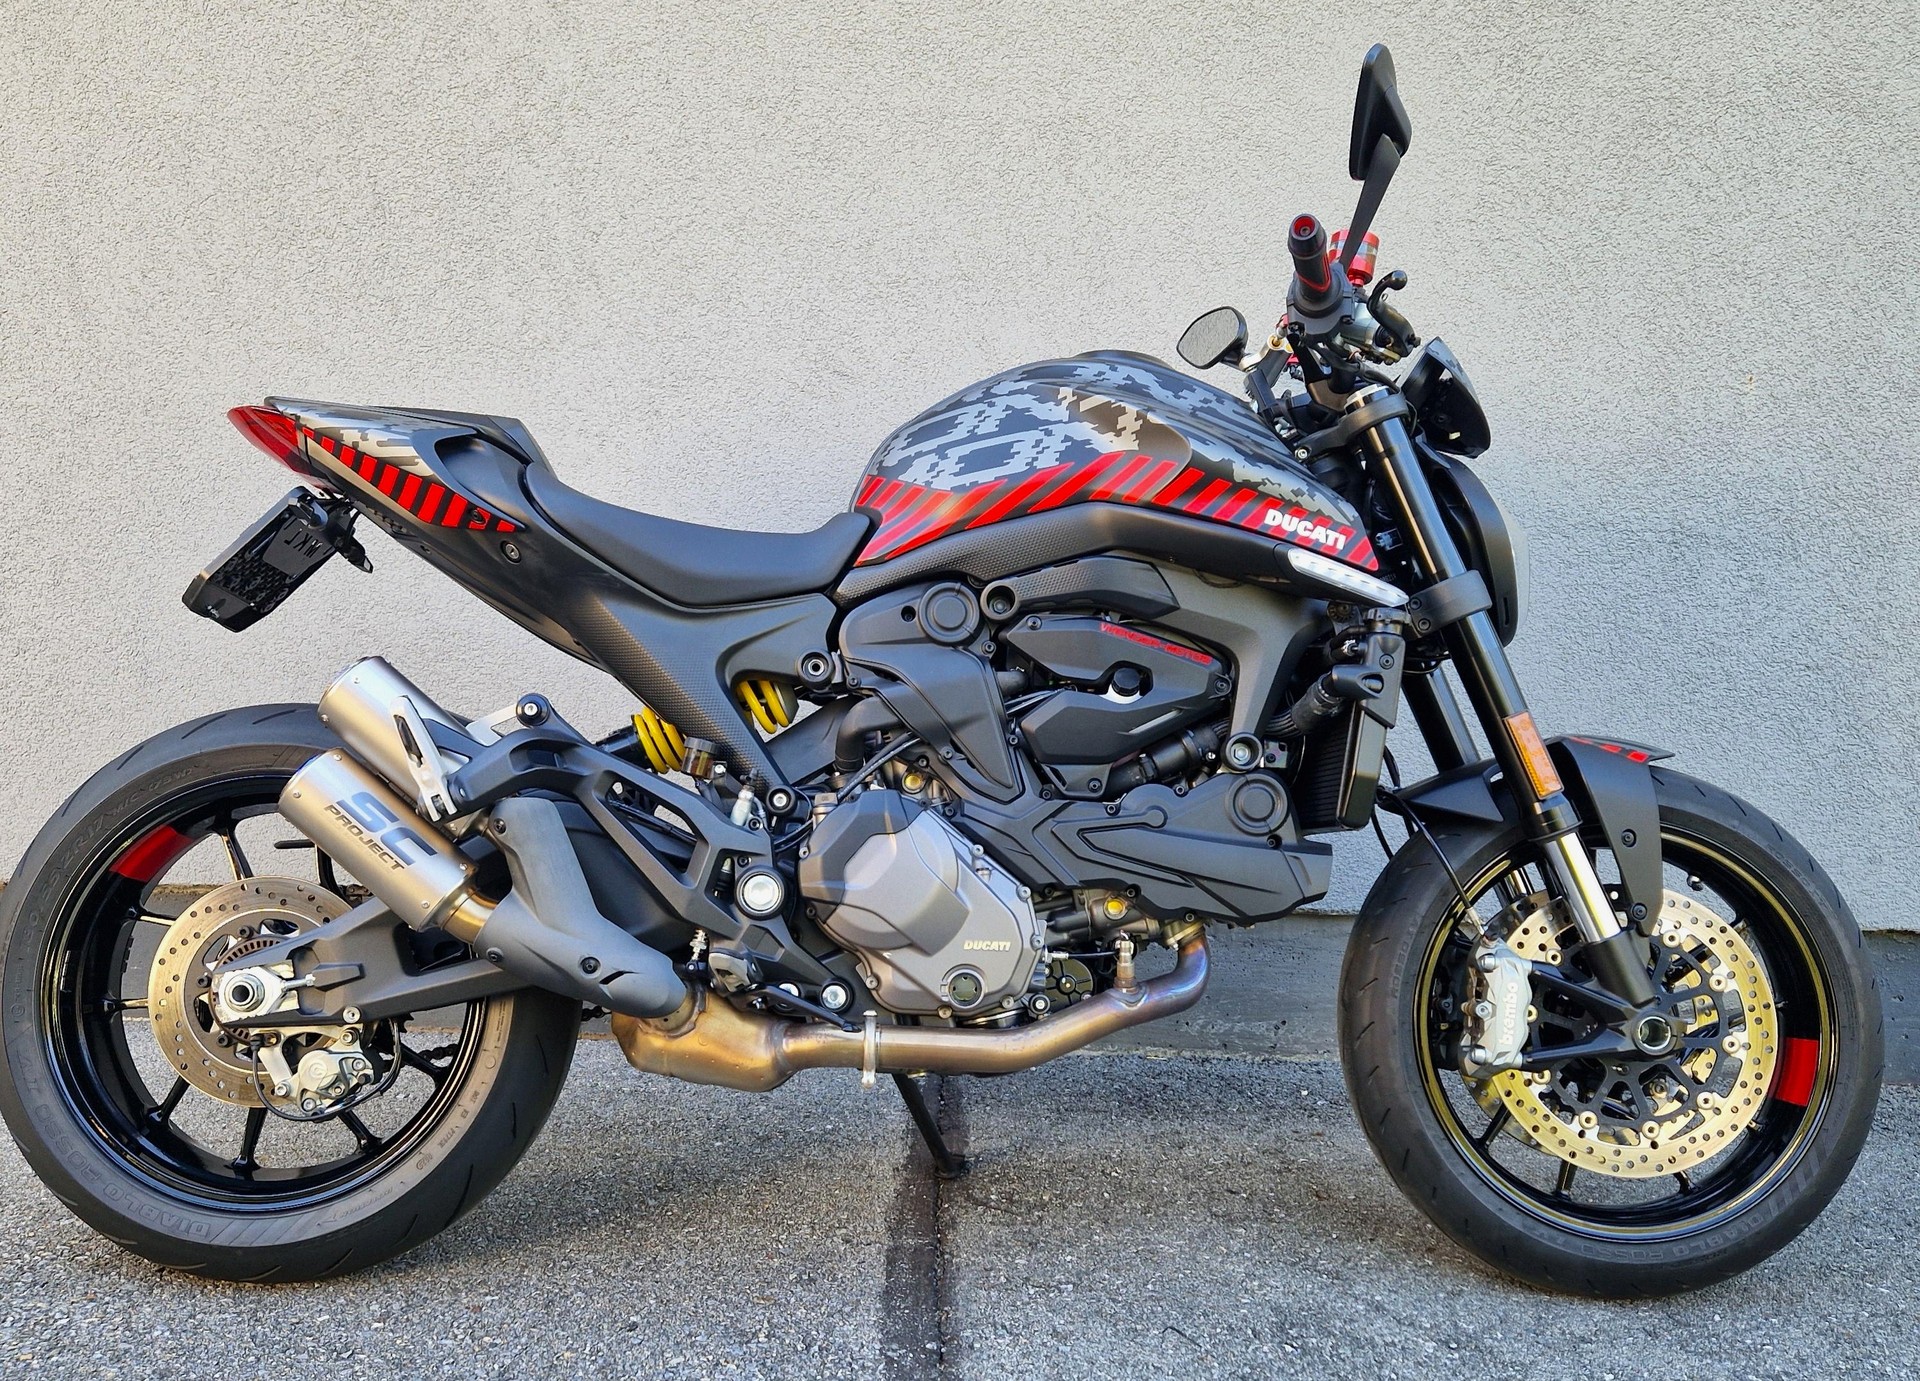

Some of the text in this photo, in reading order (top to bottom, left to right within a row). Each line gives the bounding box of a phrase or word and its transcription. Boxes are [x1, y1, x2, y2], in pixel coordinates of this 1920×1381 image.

[1264, 508, 1347, 550] DUCATI
[324, 804, 405, 870] PROJECT
[336, 791, 438, 866] SC
[963, 940, 1011, 951] DUCATI
[1499, 982, 1519, 1045] brembo
[35, 1103, 101, 1182] ROSSO
[103, 1182, 212, 1239] DIABLO
[1673, 1215, 1764, 1256] DIABLO
[1581, 1243, 1664, 1260] ROSSO
